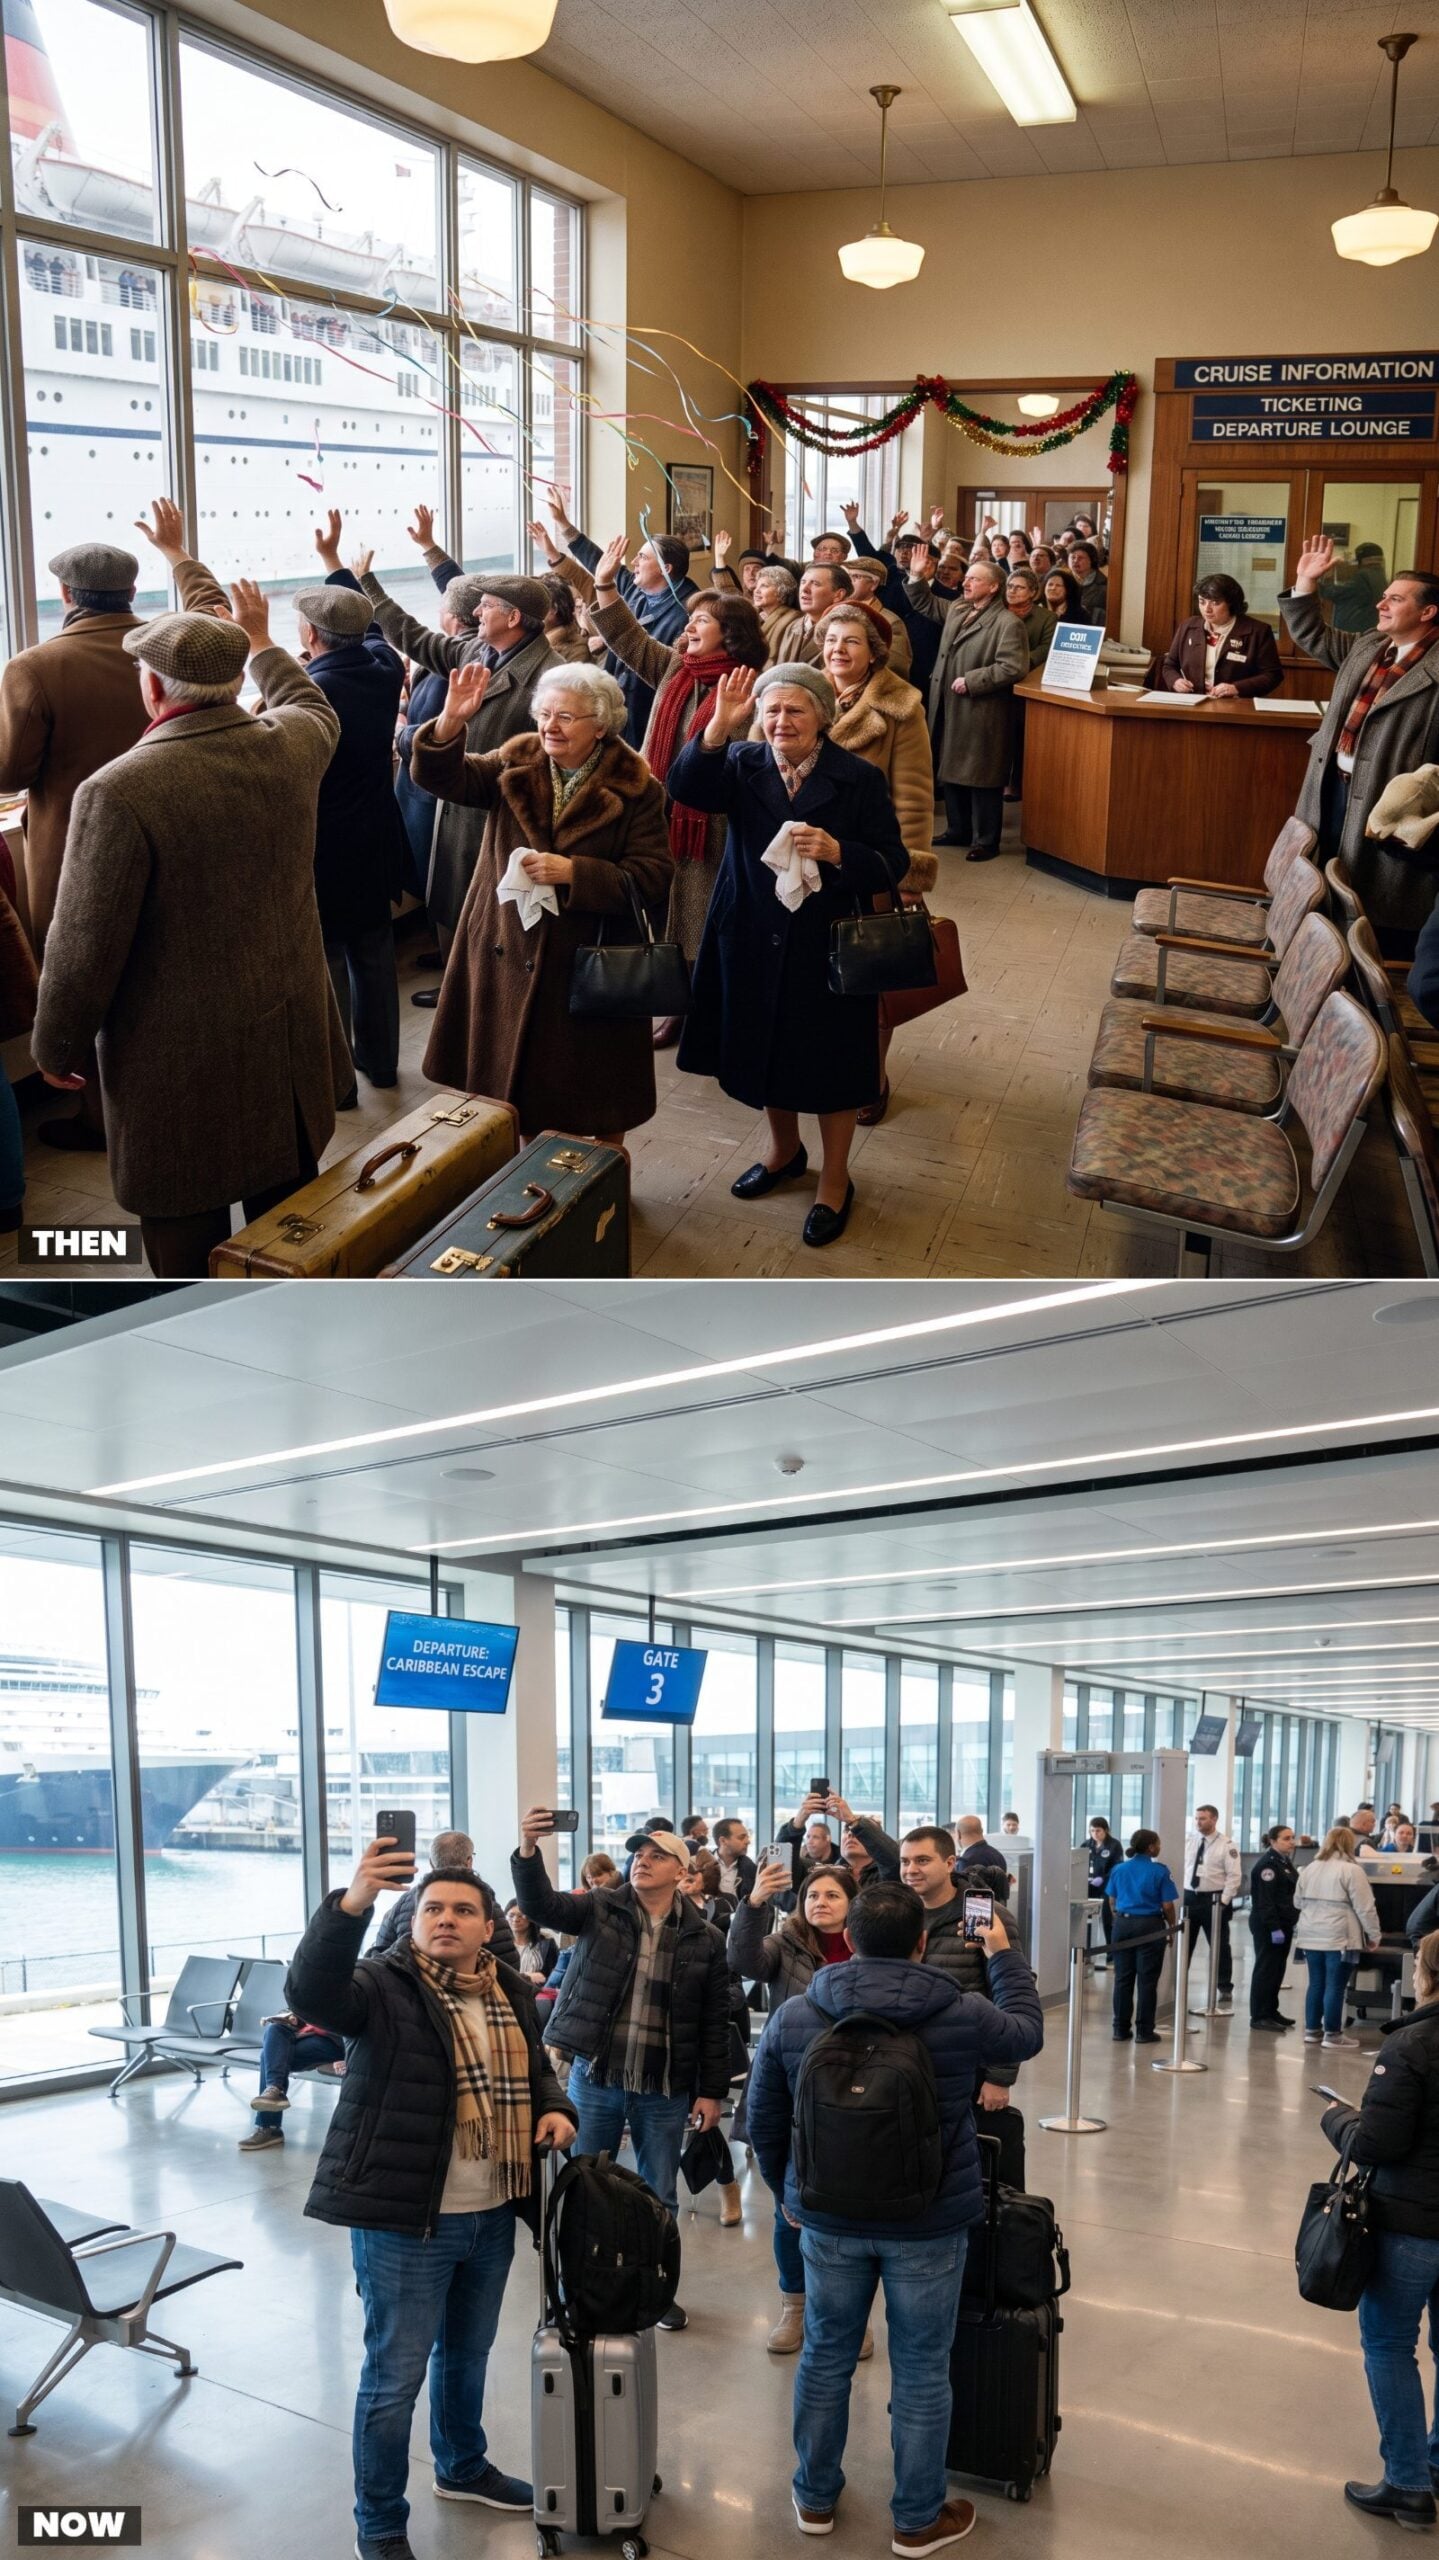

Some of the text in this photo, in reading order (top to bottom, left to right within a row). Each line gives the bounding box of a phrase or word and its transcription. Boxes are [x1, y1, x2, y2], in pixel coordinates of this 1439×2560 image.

[1194, 361, 1434, 383] CRUISE INFORMATION
[1261, 396, 1363, 412] TICKETING
[1212, 420, 1410, 437] DEPARTURE LOUNGE
[413, 1639, 490, 1660] DEPARTURE:
[643, 1649, 680, 1669] GATE
[386, 1657, 507, 1680] CARIBBEAN ESCAPE
[645, 1673, 664, 1705] 3
